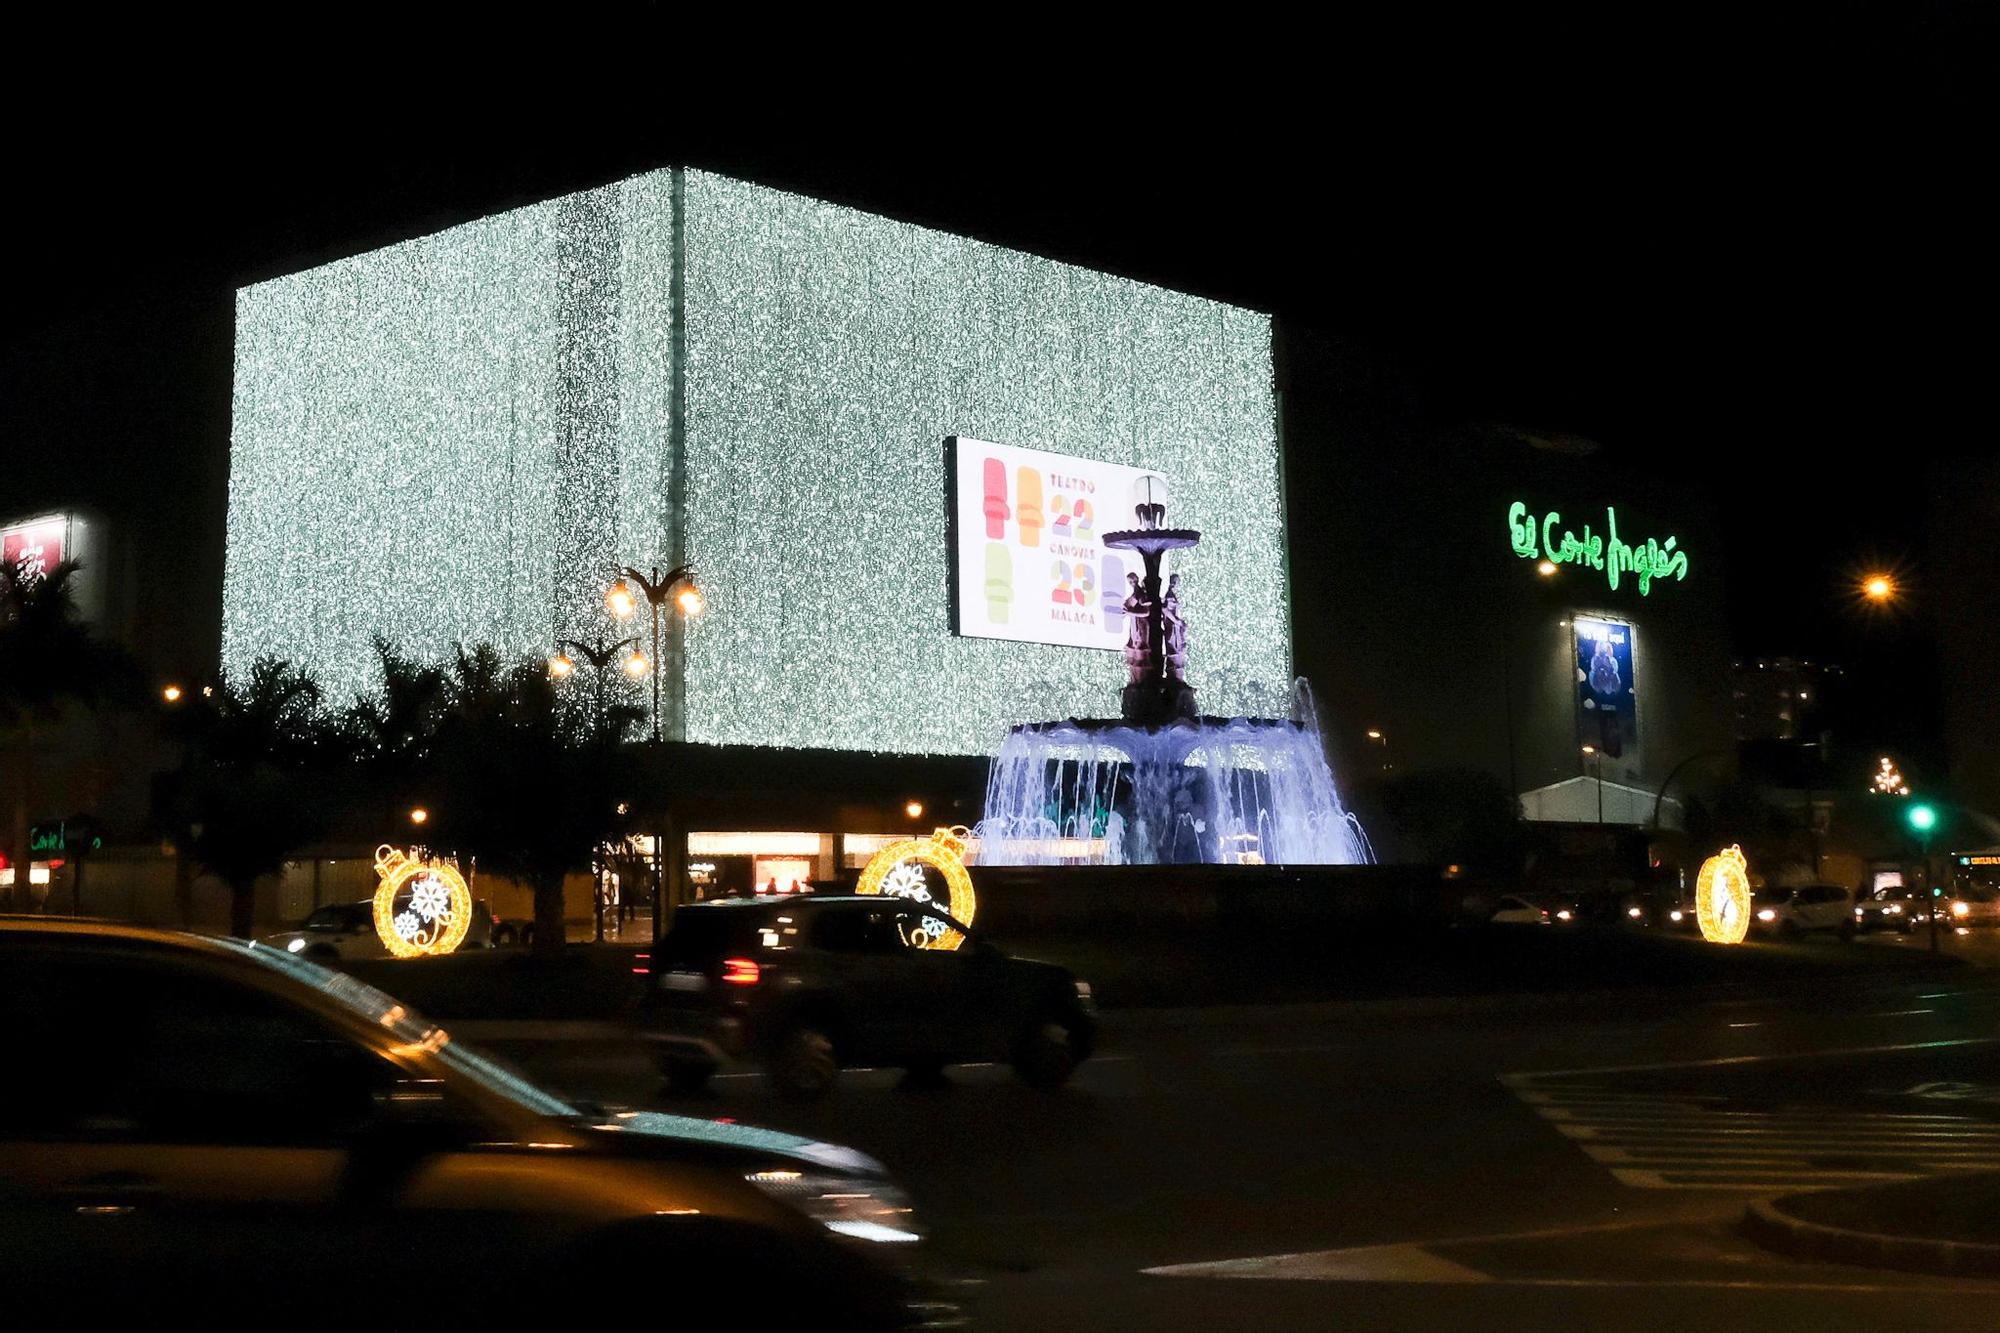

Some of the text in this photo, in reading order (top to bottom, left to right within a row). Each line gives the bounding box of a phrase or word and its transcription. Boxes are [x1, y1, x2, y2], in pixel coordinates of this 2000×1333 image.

[1050, 474, 1096, 495] TEATRO
[1051, 494, 1094, 541] 22
[1508, 501, 1688, 597] El Corte Inglés
[1050, 560, 1096, 607] 23
